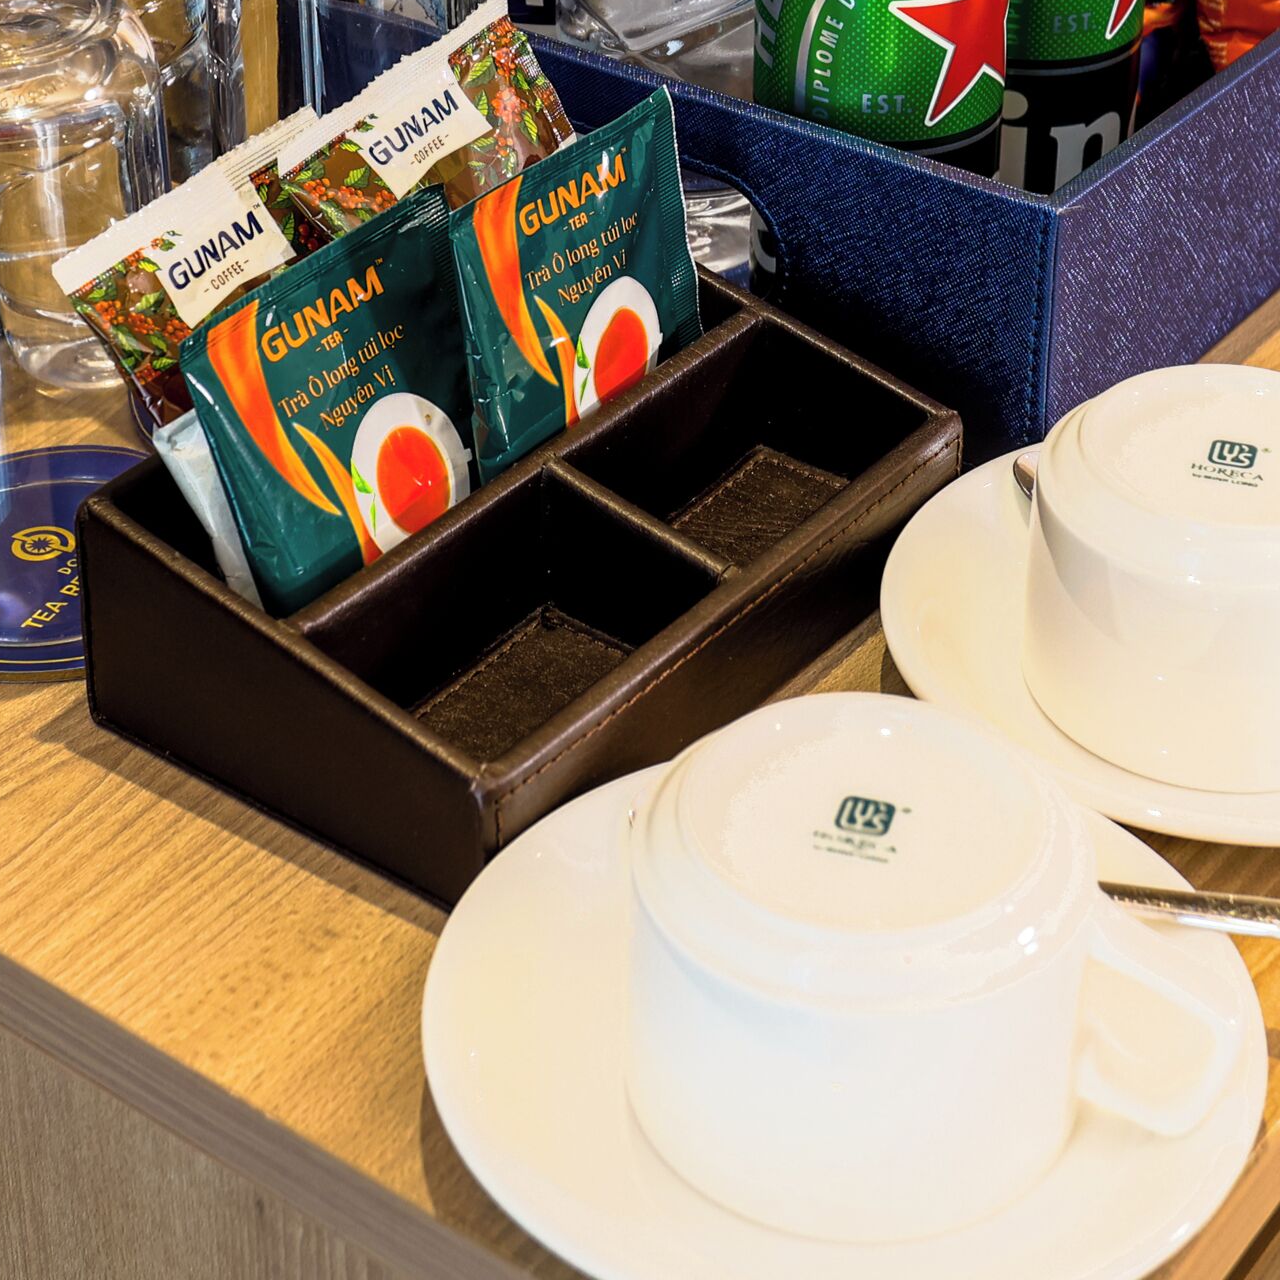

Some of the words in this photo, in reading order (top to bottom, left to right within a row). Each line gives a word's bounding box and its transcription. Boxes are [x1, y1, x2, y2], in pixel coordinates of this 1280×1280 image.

[368, 87, 461, 166] GUNAM
[859, 91, 913, 116] EST.
[412, 136, 446, 166] COFFEE
[518, 153, 627, 237] GUNAM
[569, 211, 589, 232] TEA
[167, 210, 265, 291] GUNAM
[210, 261, 246, 291] COFFEE
[525, 264, 552, 292] Trà
[551, 252, 565, 275] Ô
[565, 238, 600, 268] long
[600, 221, 620, 247] túi
[620, 211, 639, 236] lọc
[557, 266, 613, 308] Nguyên
[612, 248, 628, 271] Vị
[260, 264, 385, 363] GUNAM
[320, 330, 344, 352] TEA
[277, 389, 311, 419] Trà
[308, 375, 324, 398] Ô
[322, 356, 360, 390] long
[357, 336, 380, 365] túi
[376, 323, 405, 351] lọc
[319, 382, 376, 431] Nguyên
[373, 364, 397, 388] Vị
[20, 599, 69, 629] TEA
